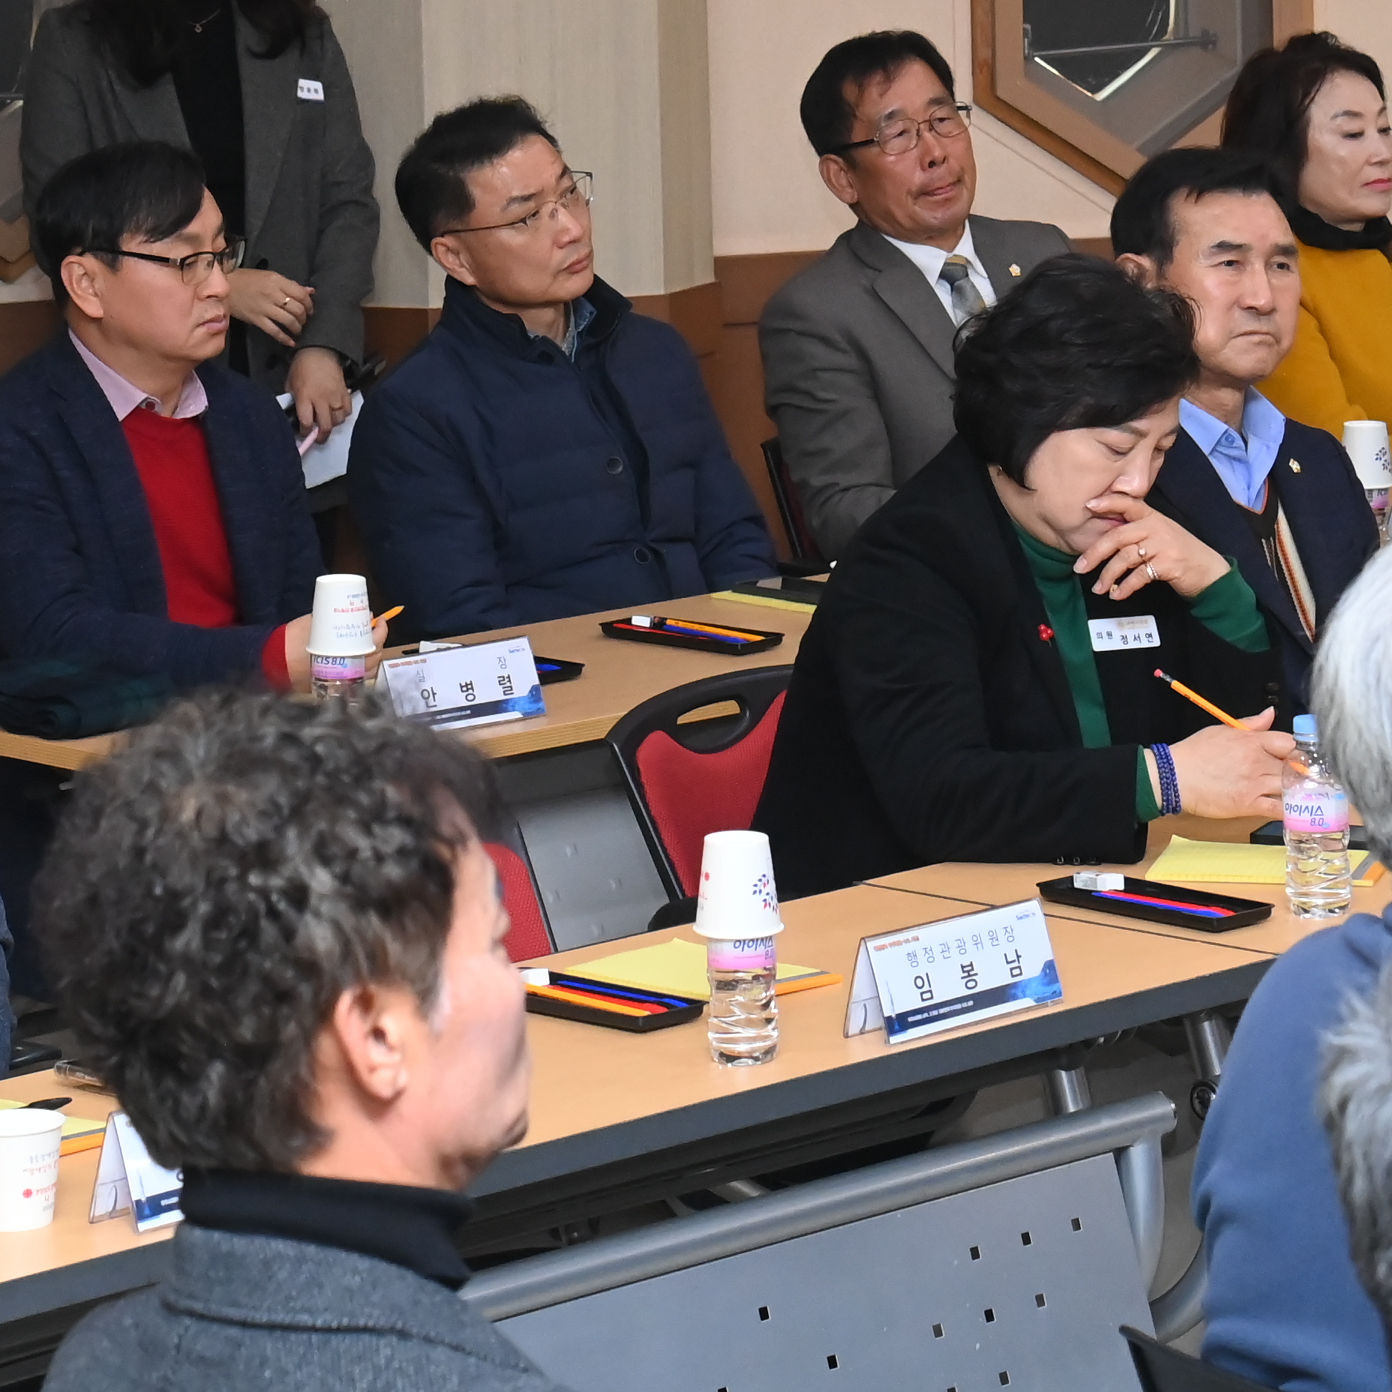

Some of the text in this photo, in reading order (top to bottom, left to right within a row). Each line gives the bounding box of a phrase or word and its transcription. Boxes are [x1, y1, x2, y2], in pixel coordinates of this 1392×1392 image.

[1120, 632, 1154, 645] 정서연
[420, 673, 515, 709] 안병렬
[1285, 802, 1325, 817] 아이시스
[1310, 817, 1325, 827] 8.0
[905, 924, 1016, 968] 행정관광위원장
[913, 949, 1024, 1003] 임봉남
